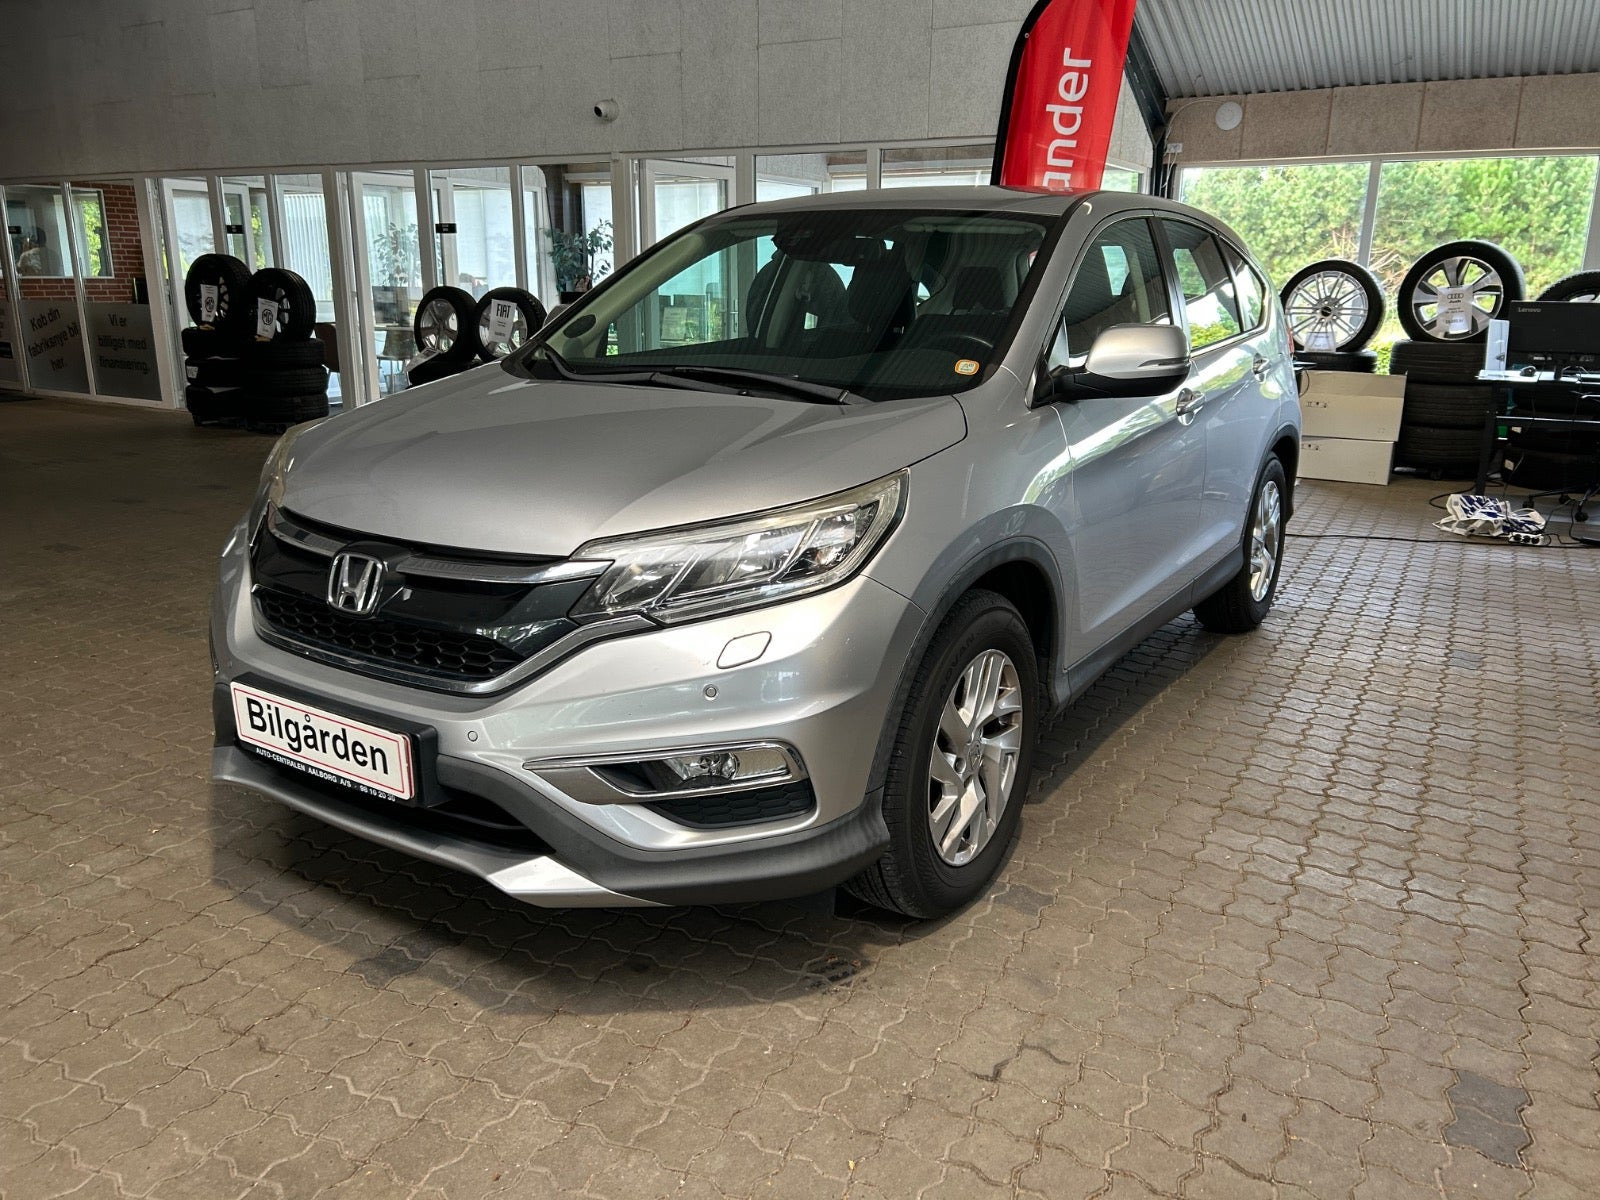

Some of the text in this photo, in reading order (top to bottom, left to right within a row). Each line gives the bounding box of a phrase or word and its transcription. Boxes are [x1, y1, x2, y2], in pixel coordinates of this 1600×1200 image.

[108, 313, 119, 327] Vi
[496, 303, 511, 319] FIAT
[246, 697, 389, 775] Bilgården
[256, 747, 306, 772] AUTO-CENTRALEN
[308, 767, 337, 784] AALBORG
[340, 778, 352, 788] A/S
